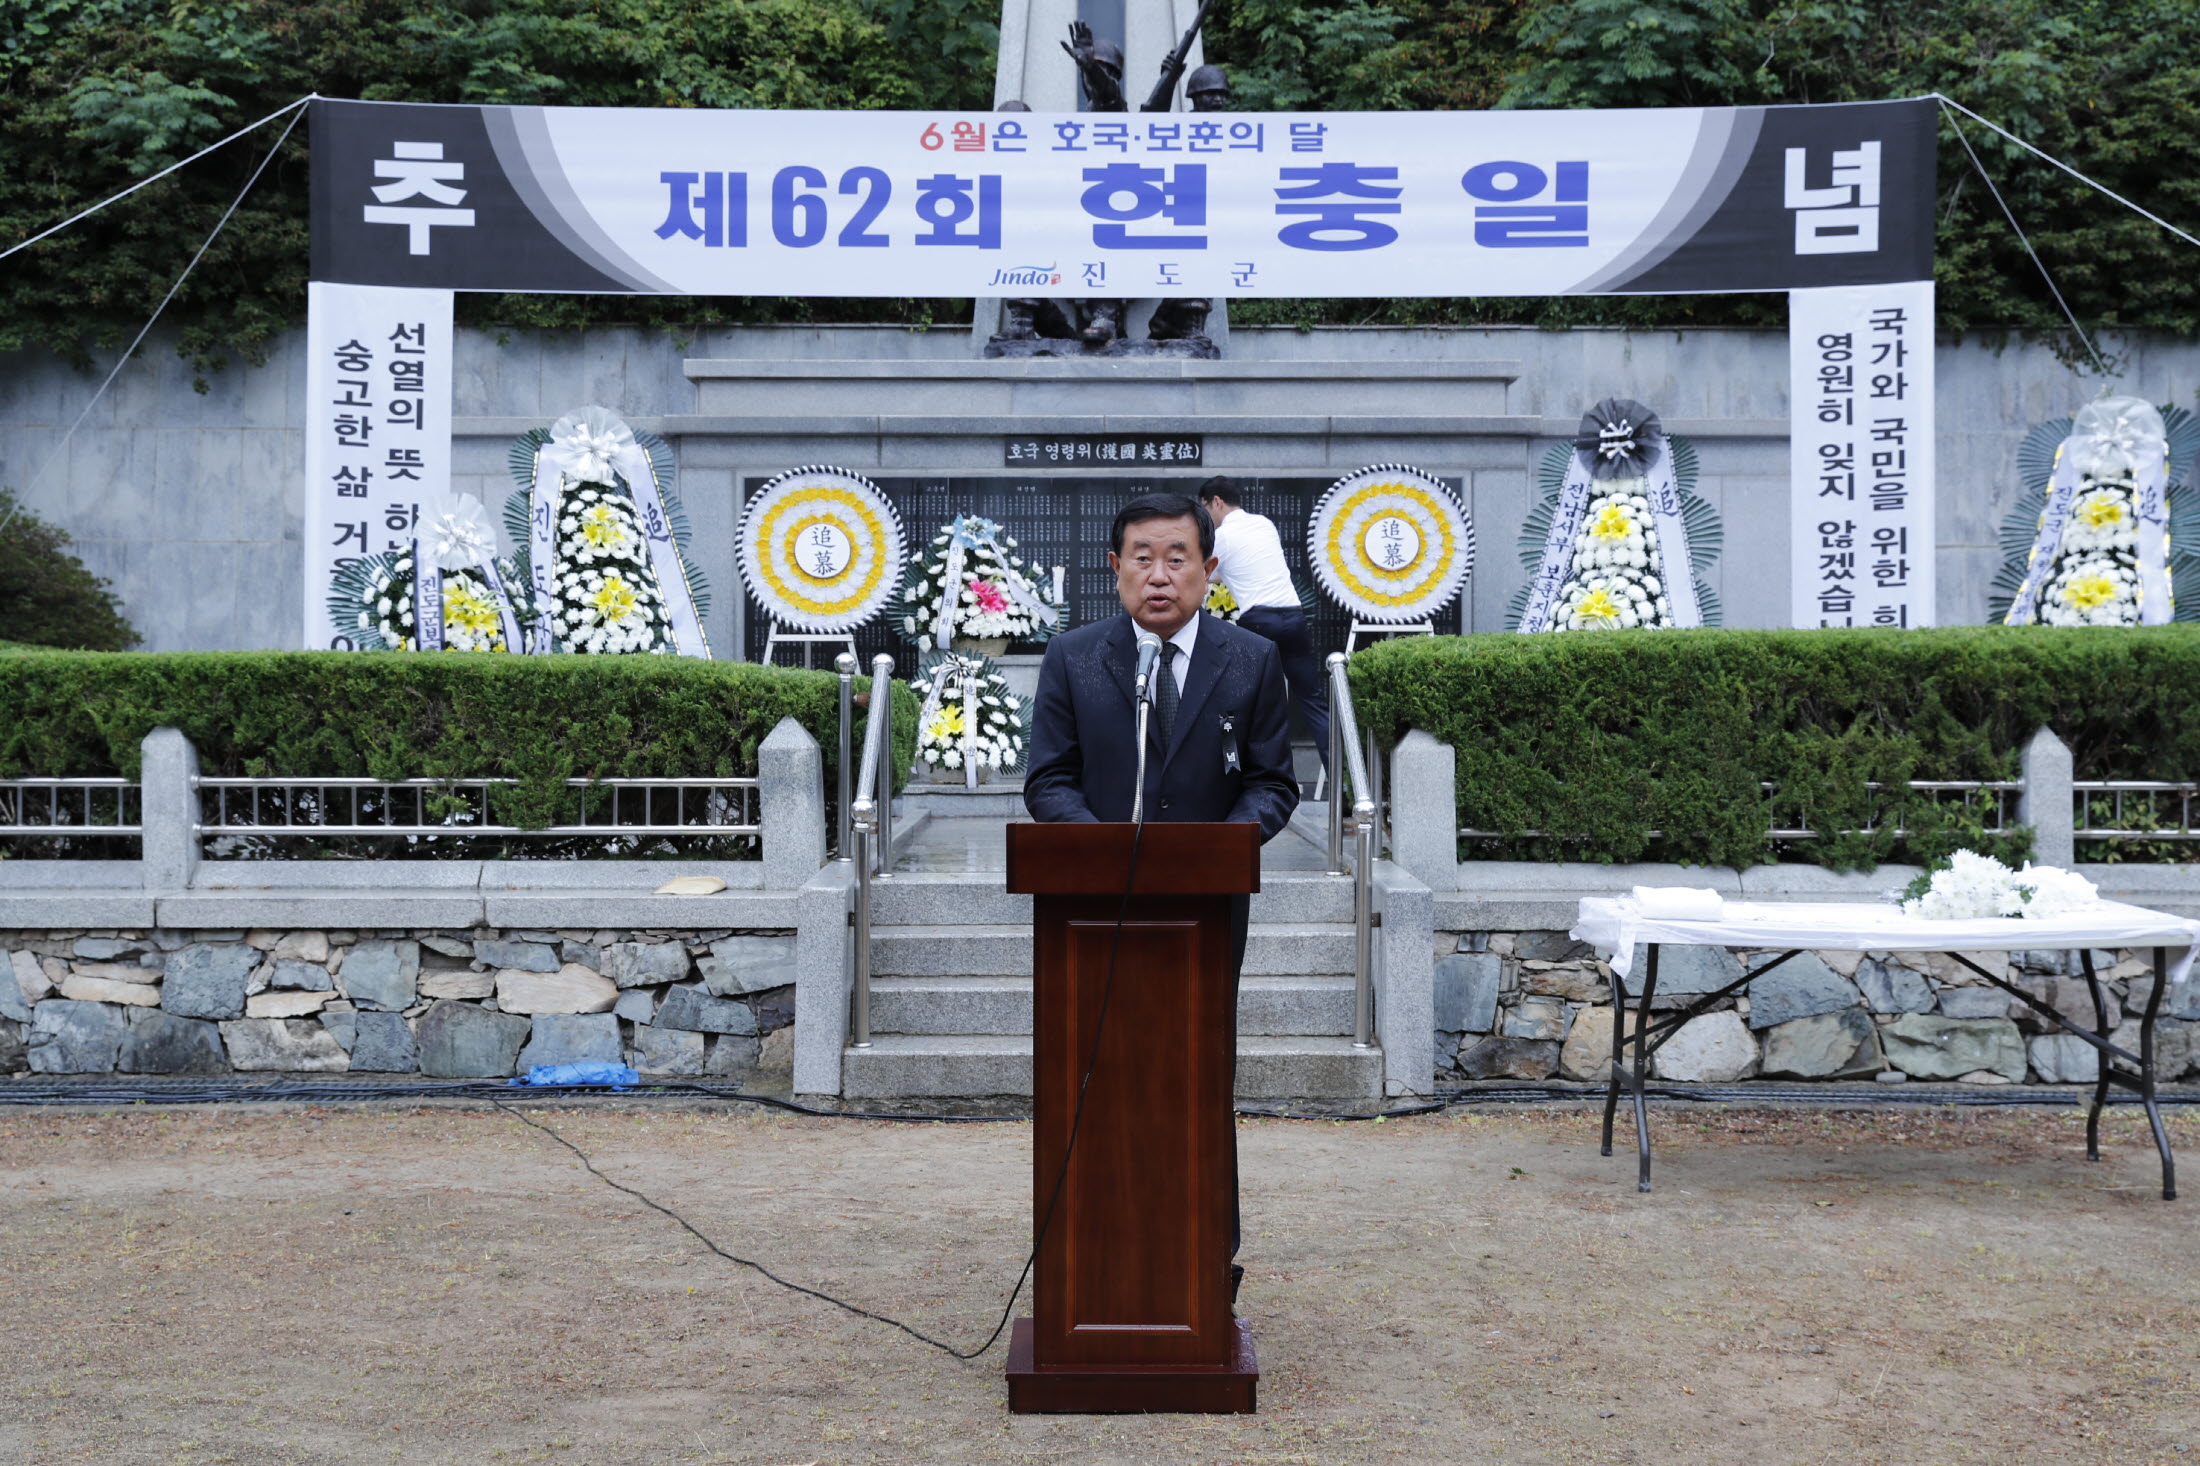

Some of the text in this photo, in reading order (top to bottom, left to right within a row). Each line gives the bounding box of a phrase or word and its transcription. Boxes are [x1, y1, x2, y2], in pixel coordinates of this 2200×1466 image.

[921, 120, 1329, 152] 6월은 호국·보훈의 달
[364, 142, 475, 255] 추
[655, 166, 1002, 250] 제62회
[1784, 140, 1881, 254] 념
[387, 322, 426, 430] 선열의
[1817, 332, 1854, 426] 영원히
[1869, 307, 1909, 400] 국가와
[333, 339, 373, 448] 숭고한
[332, 465, 373, 498] 삶
[384, 448, 424, 481] 뜻
[1007, 442, 1040, 460] 호국
[1818, 442, 1855, 500] 잊지
[1869, 417, 1909, 511] 국민을
[811, 525, 837, 575] 追慕
[1381, 519, 1406, 567] 追慕
[1870, 526, 1911, 587] 위한
